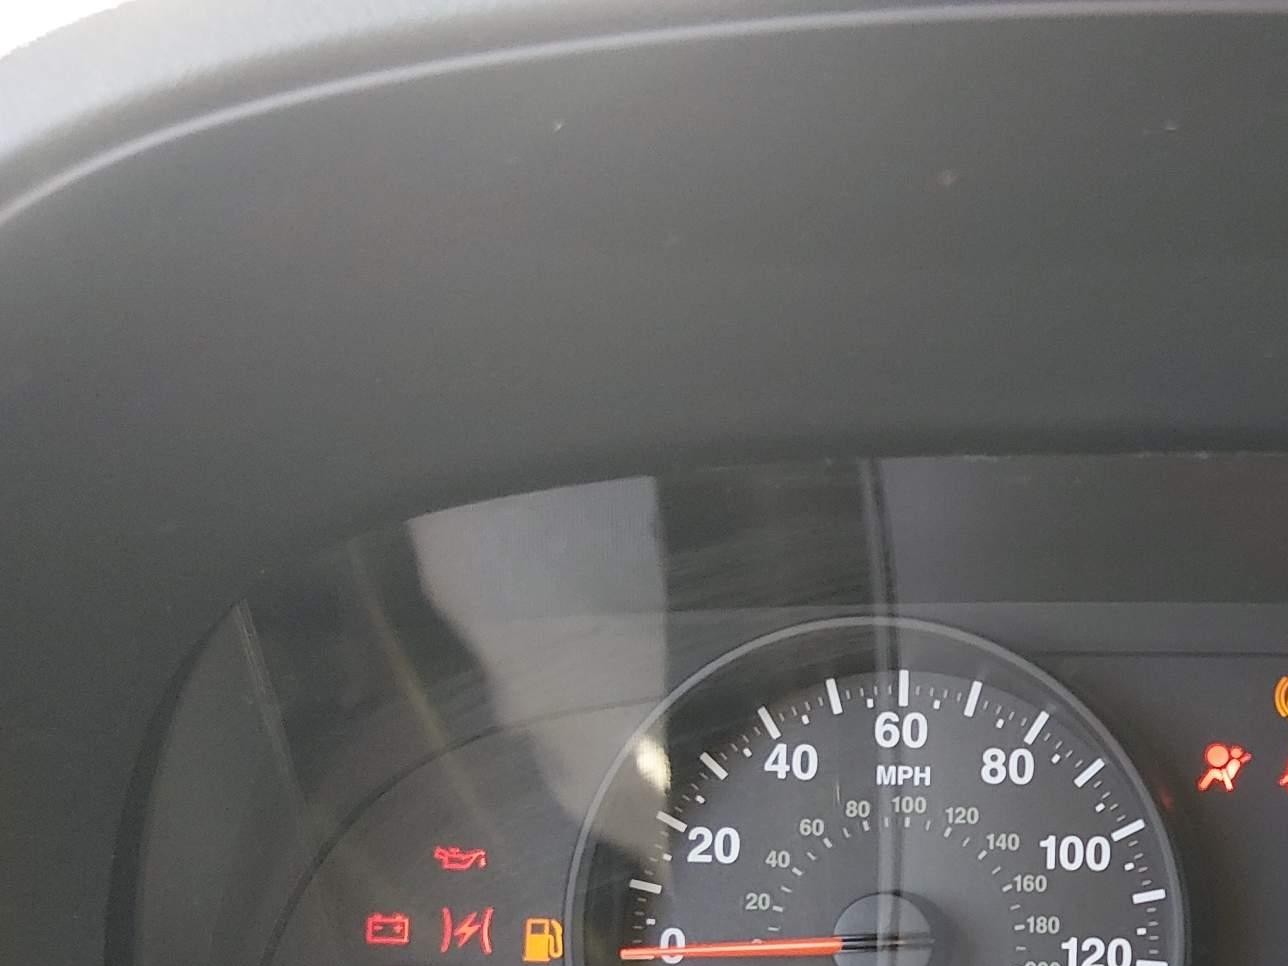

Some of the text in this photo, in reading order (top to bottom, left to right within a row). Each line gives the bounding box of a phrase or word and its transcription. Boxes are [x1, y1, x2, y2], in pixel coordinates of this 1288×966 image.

[874, 712, 928, 748] 60
[764, 744, 818, 780] 40
[980, 748, 1034, 784] 80
[876, 766, 931, 786] MPH
[846, 800, 870, 818] 80
[891, 796, 926, 814] 100
[945, 806, 979, 824] 120
[800, 818, 824, 836] 60
[688, 827, 740, 863] 20
[986, 834, 1020, 851] 140
[766, 850, 790, 868] 40
[1040, 836, 1111, 872] 100
[1014, 874, 1047, 893] 160
[746, 894, 770, 910] 20
[1026, 916, 1060, 934] 180
